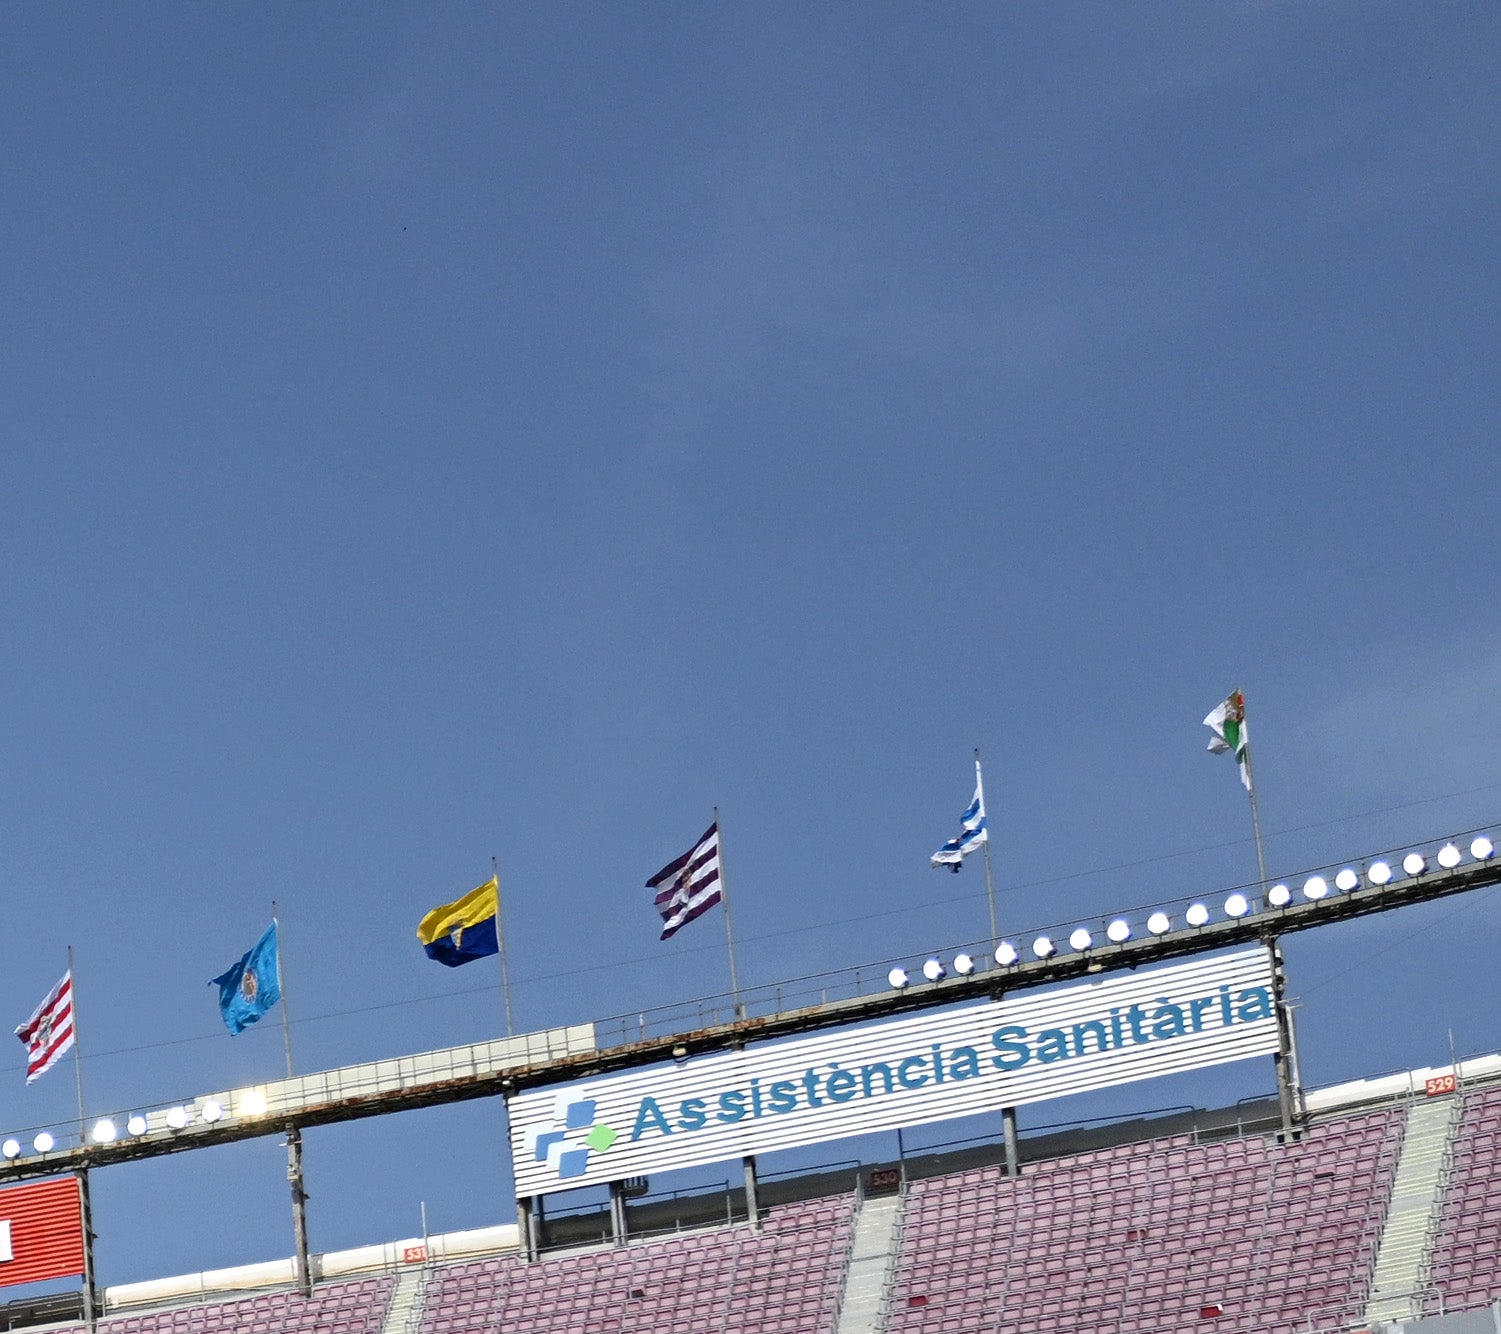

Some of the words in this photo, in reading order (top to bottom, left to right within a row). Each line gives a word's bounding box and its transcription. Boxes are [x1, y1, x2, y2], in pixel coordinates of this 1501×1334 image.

[630, 1040, 981, 1142] Assistència
[992, 985, 1273, 1071] Sanitària
[1427, 1077, 1454, 1095] 529
[406, 1247, 426, 1260] 531
